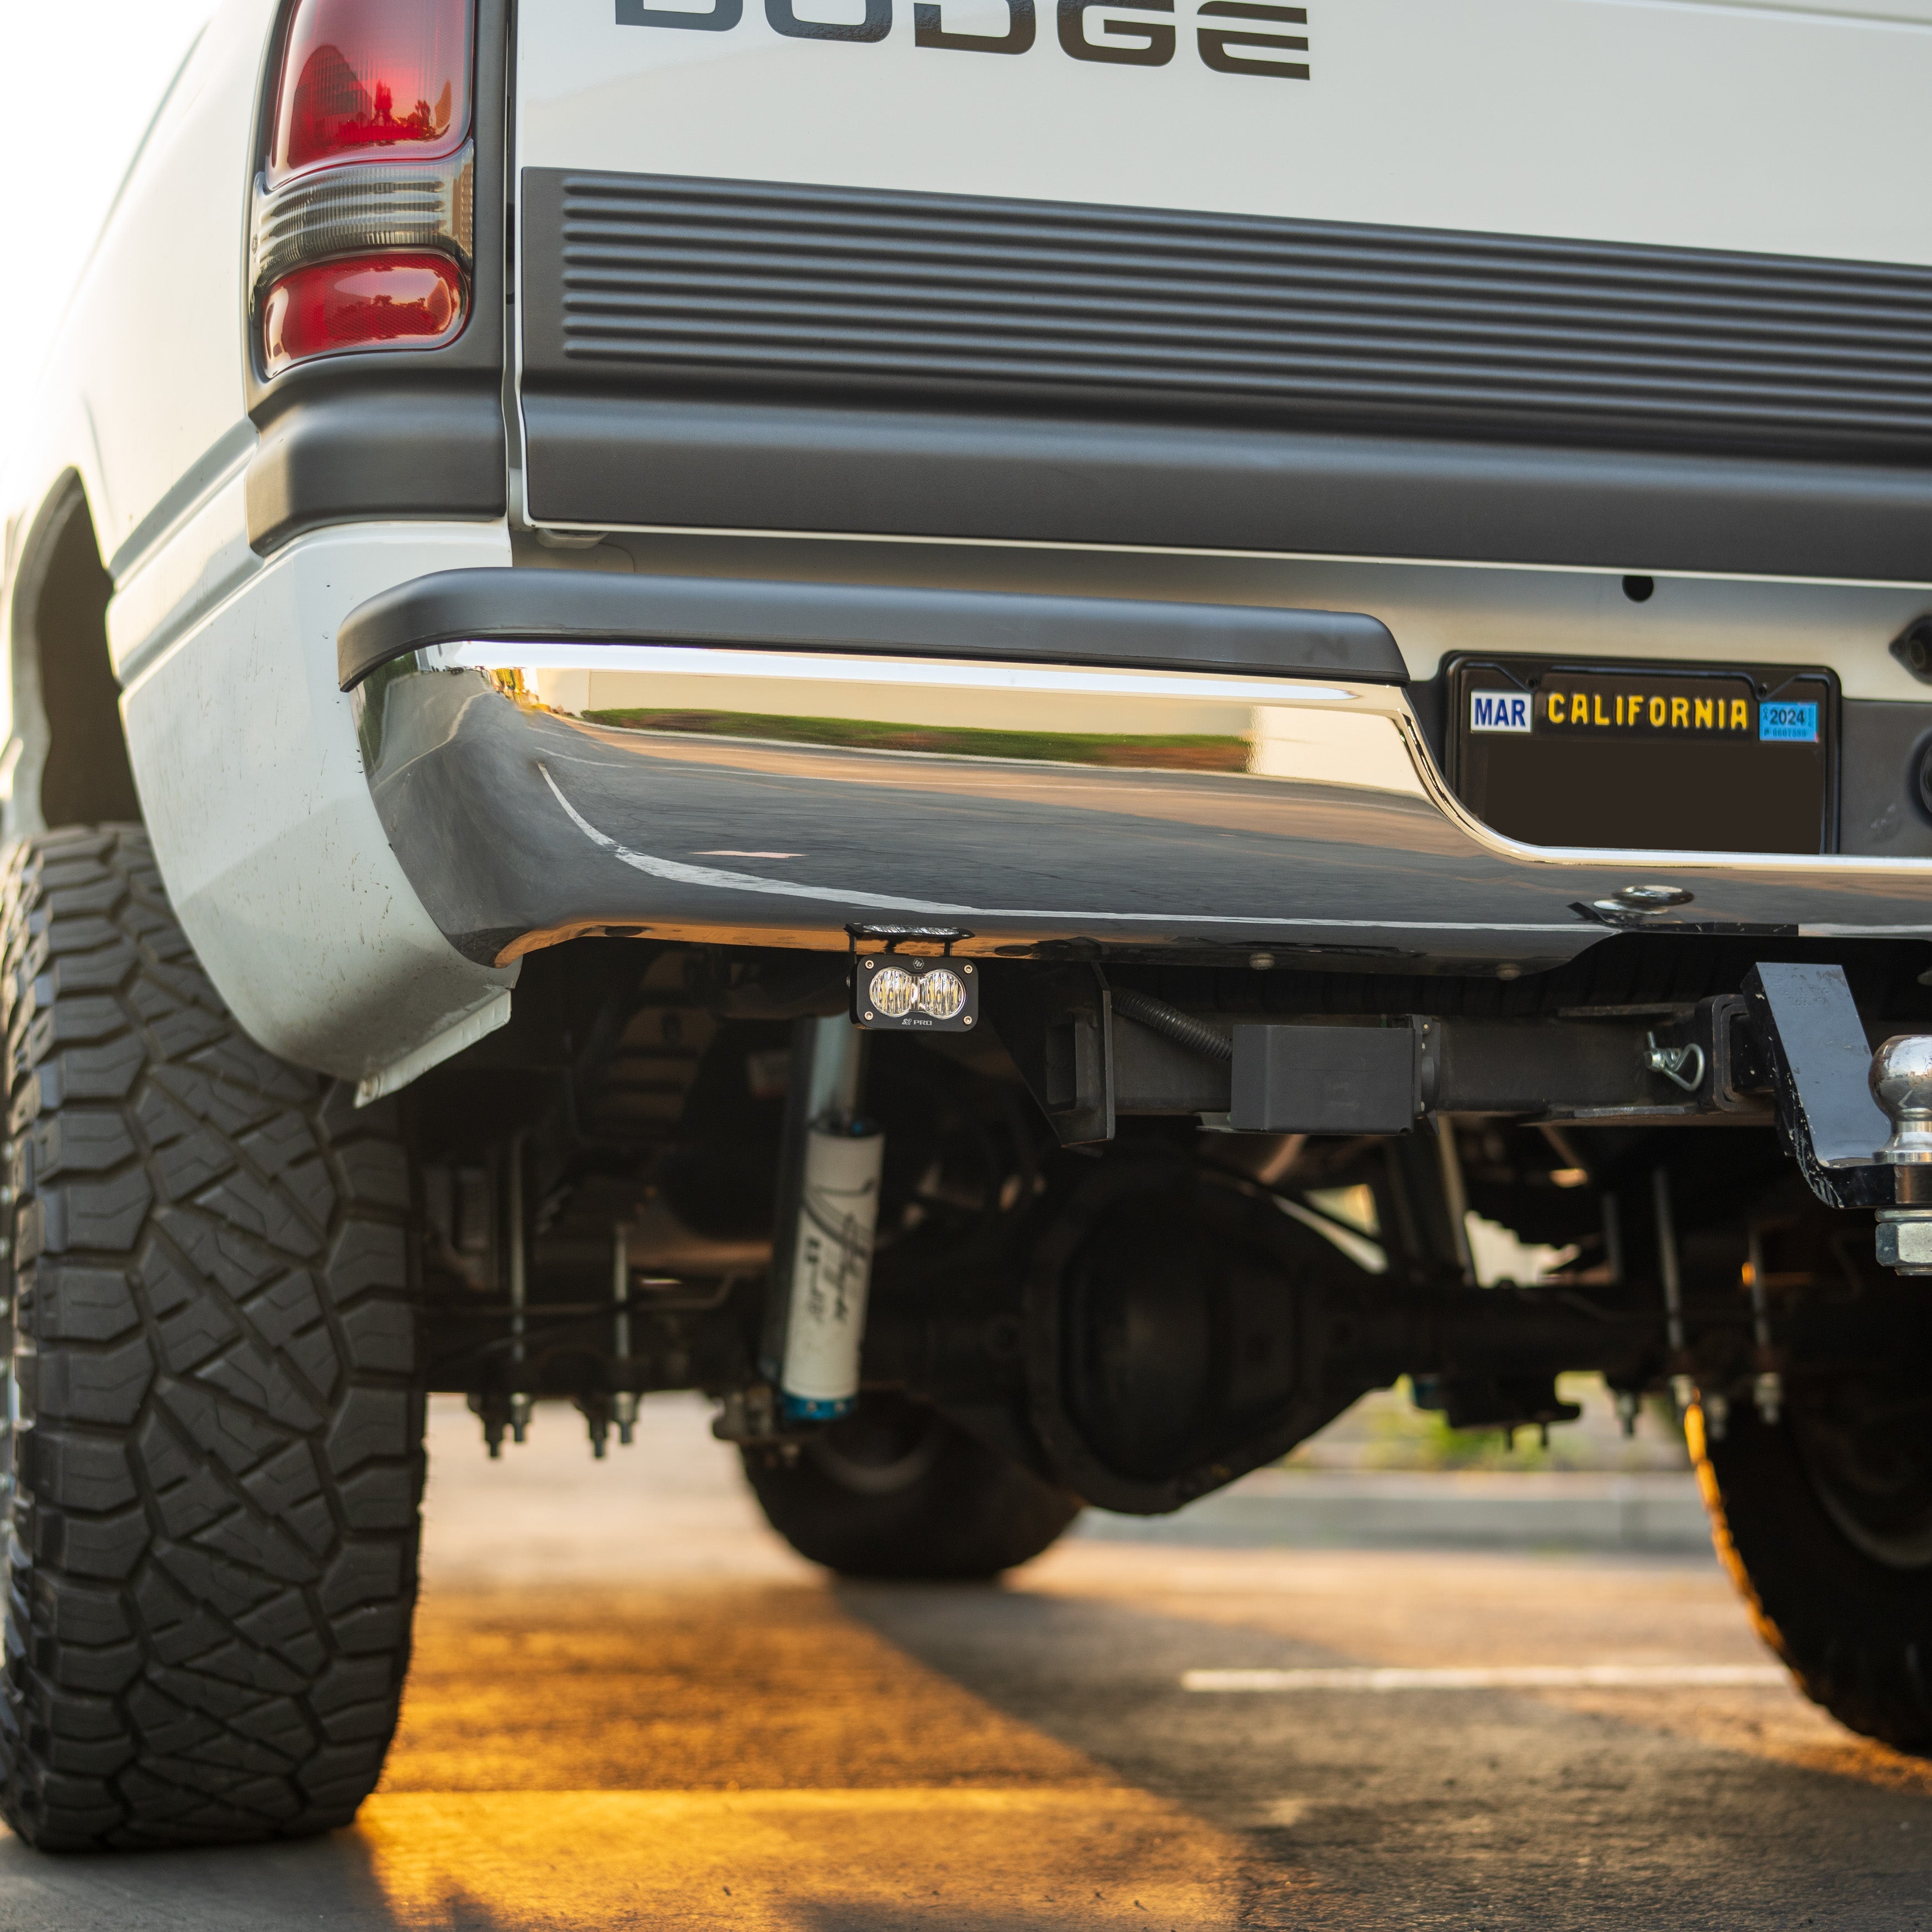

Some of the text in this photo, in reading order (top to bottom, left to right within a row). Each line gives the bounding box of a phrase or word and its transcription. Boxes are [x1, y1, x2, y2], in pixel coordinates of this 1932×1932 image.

[1474, 698, 1526, 728] MAR
[1548, 692, 1748, 730] CALIFORNIA
[1769, 709, 1805, 725] 2024
